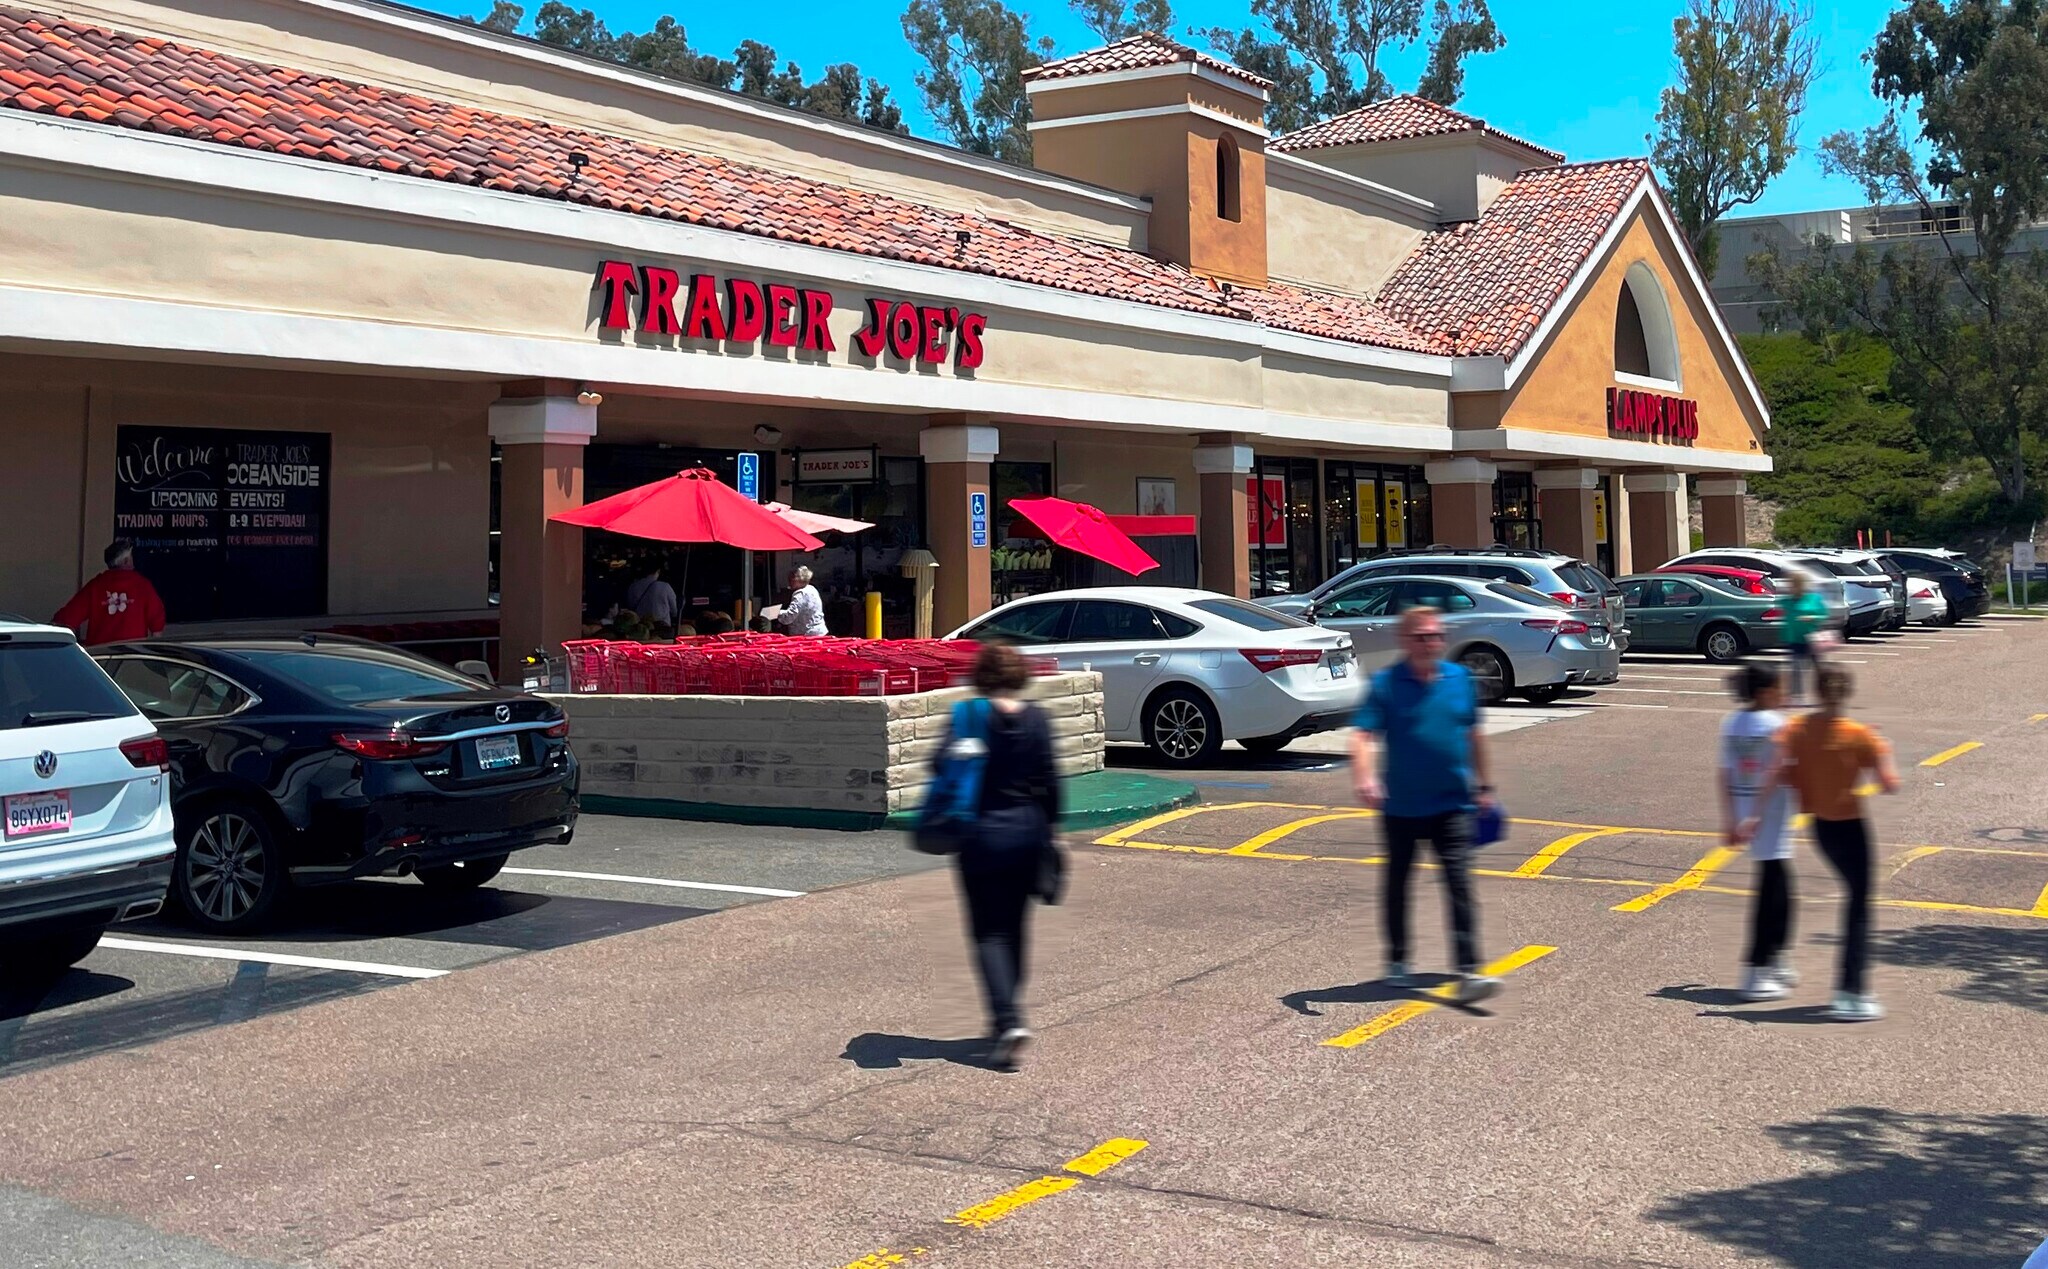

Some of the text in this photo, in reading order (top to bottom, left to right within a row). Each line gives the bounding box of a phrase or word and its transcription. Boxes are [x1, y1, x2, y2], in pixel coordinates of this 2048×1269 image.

[598, 260, 988, 369] TRADER JOE'S
[1608, 387, 1699, 440] LAMPS PLUS
[116, 435, 217, 484] Welcome
[236, 443, 278, 463] TRADER
[282, 445, 311, 463] JOE'S
[803, 460, 870, 471] TRADER JOE'S
[151, 491, 285, 508] UPCOMING EVENTS!
[117, 513, 164, 528] TRADING
[229, 513, 249, 528] 8-9
[252, 514, 306, 528] EVERYDAY!
[12, 804, 67, 828] 8GYX074
